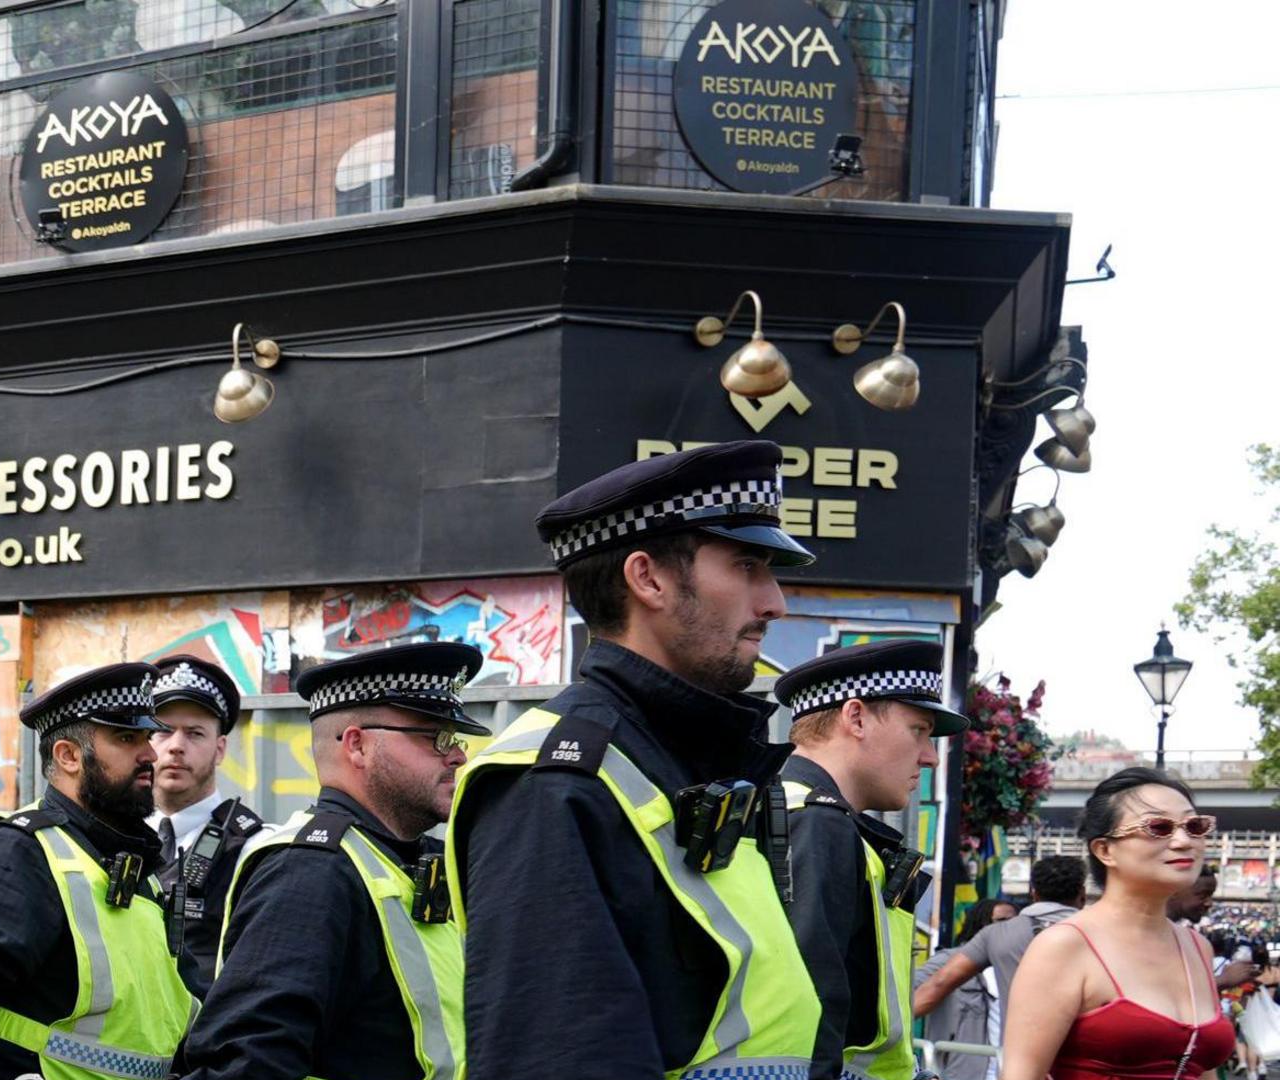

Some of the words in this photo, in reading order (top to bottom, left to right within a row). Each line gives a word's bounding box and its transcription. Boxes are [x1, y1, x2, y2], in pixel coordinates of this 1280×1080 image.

[697, 21, 841, 68] AKOYA
[702, 76, 837, 101] RESTAURANT
[36, 93, 169, 154] AKOYA
[712, 102, 826, 126] COCKTAILS
[722, 127, 816, 151] TERRACE
[41, 140, 166, 179] RESTAURANT
[49, 165, 153, 200] COCKTAILS
[58, 188, 146, 219] TERRACE
[782, 498, 857, 539] EE
[551, 750, 582, 762] 1395
